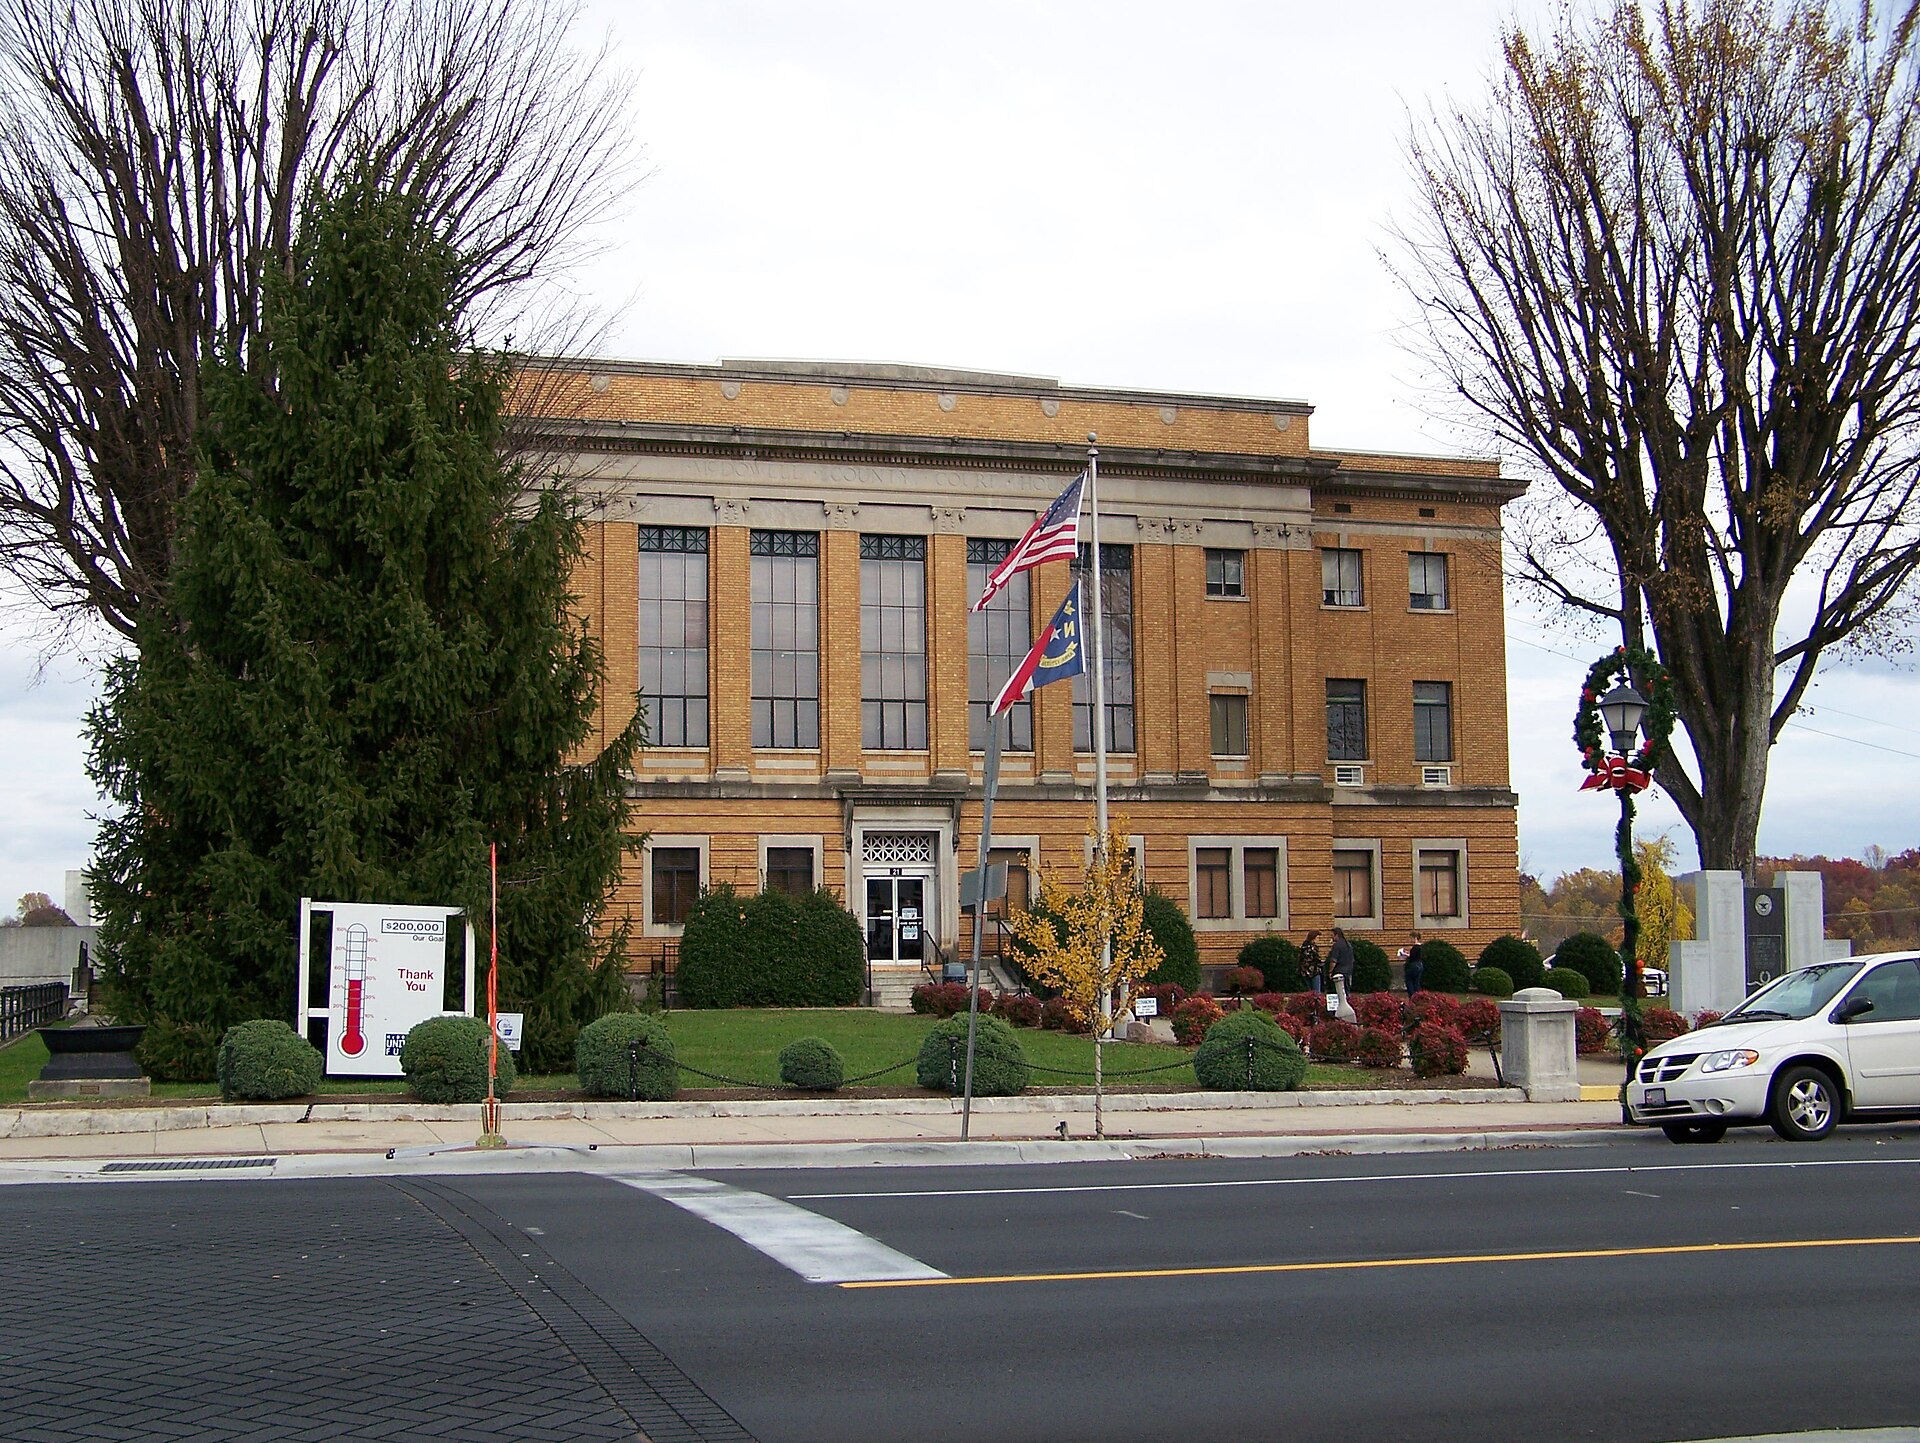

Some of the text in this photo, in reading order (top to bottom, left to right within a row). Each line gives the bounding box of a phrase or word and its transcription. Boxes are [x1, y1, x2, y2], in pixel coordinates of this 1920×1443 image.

[830, 467, 908, 485] COUNTY
[935, 471, 994, 489] COURT
[386, 923, 439, 932] $200,000
[398, 969, 434, 980] Thank
[406, 981, 426, 991] You
